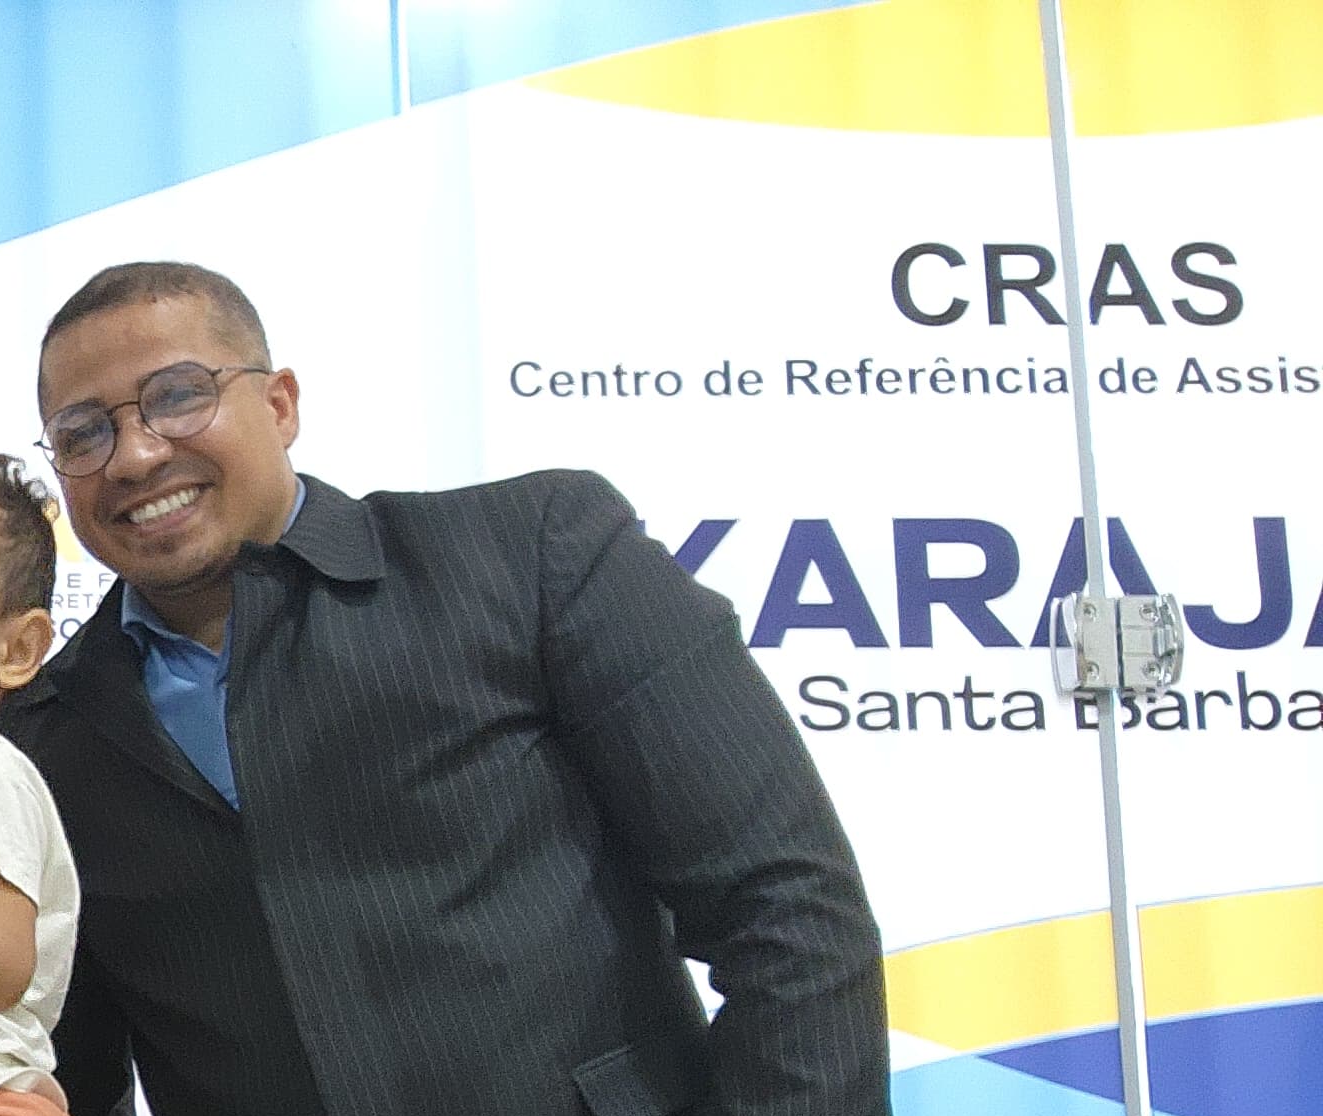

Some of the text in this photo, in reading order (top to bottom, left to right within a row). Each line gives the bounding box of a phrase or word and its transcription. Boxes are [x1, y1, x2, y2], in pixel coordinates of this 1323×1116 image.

[891, 242, 1244, 327] CRAS
[510, 361, 683, 397] Centro
[703, 360, 764, 396] de
[785, 358, 1068, 396] Referência
[1098, 357, 1157, 394] de
[635, 516, 1323, 650] ARAJ
[799, 675, 1046, 731] Santa
